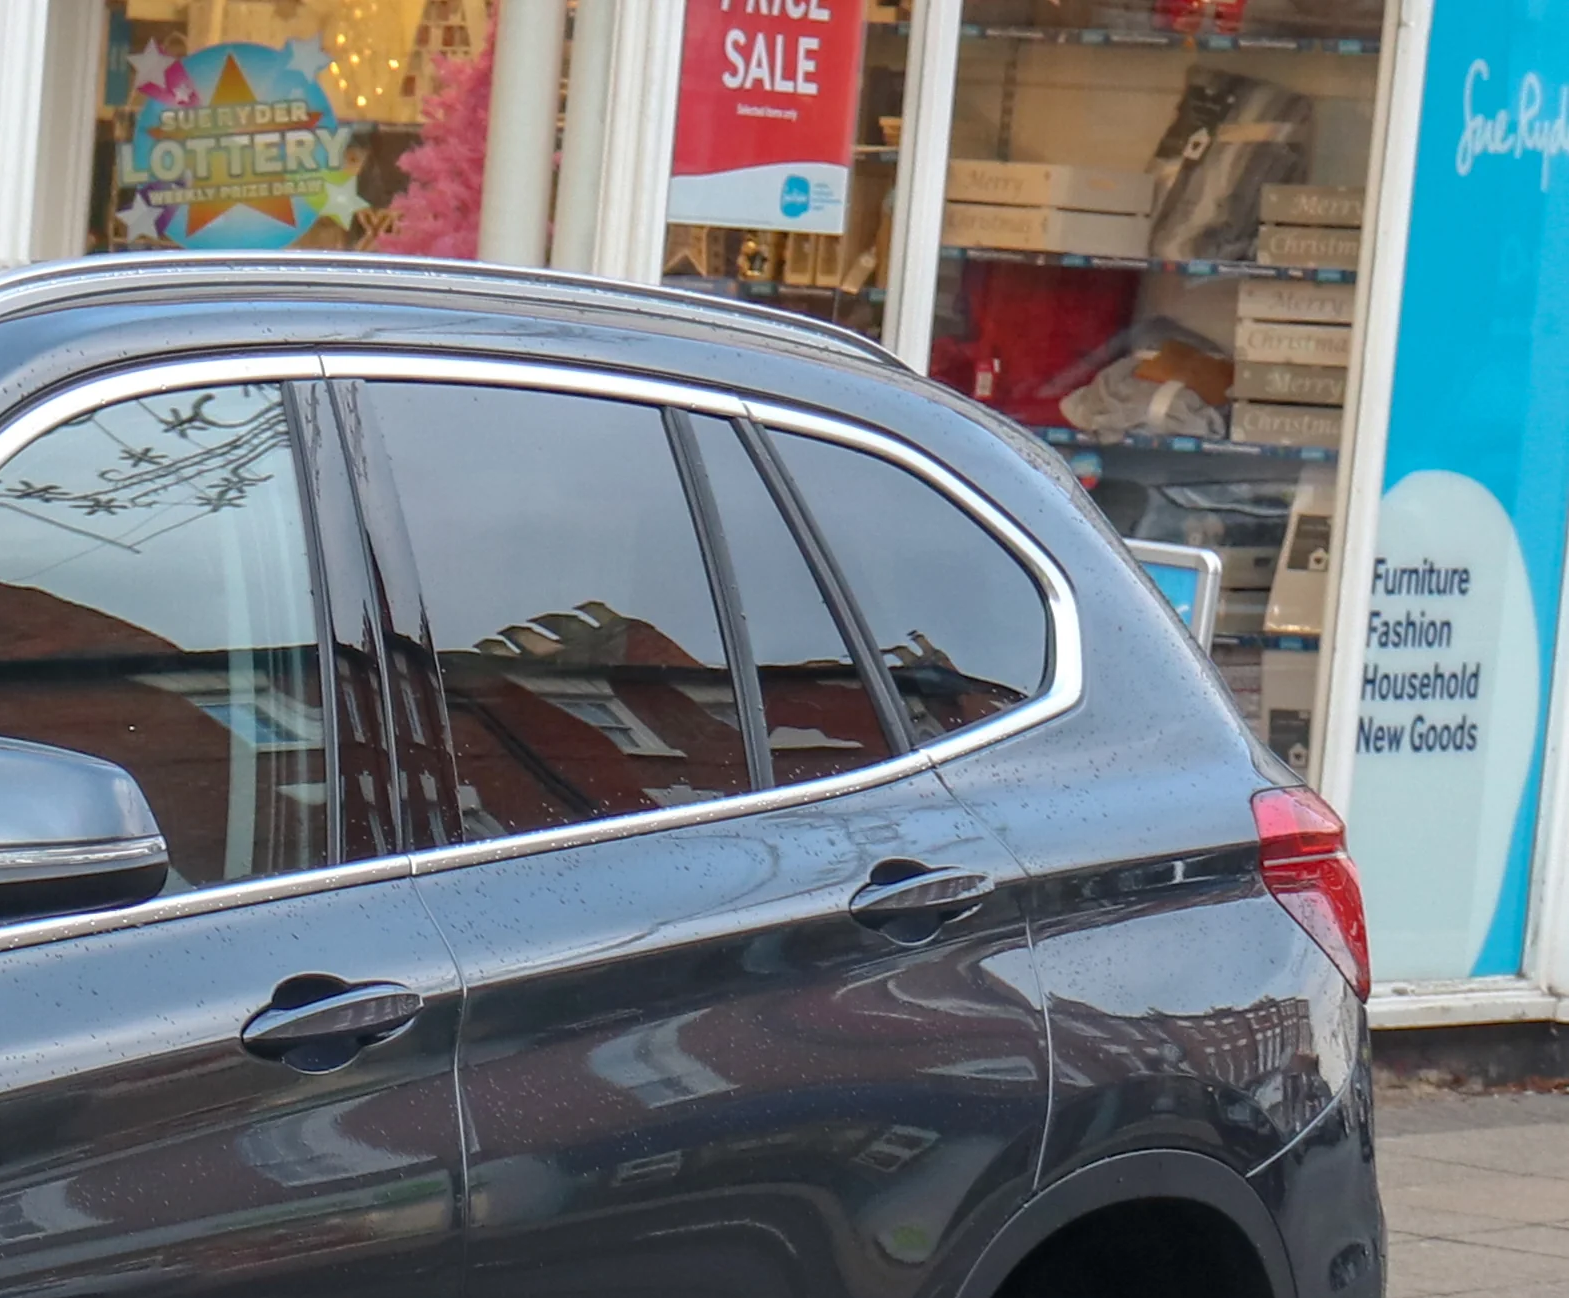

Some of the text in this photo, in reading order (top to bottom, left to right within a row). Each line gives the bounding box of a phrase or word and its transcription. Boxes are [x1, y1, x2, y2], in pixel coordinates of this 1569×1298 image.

[722, 28, 820, 96] SALE
[119, 126, 352, 184] LOTTERY
[219, 183, 270, 199] PRIZE
[272, 180, 325, 196] DRAW
[1370, 557, 1471, 596] Furniture
[1365, 610, 1452, 648] Fashion
[1361, 661, 1481, 701] Household
[1355, 713, 1479, 754] New Goods
